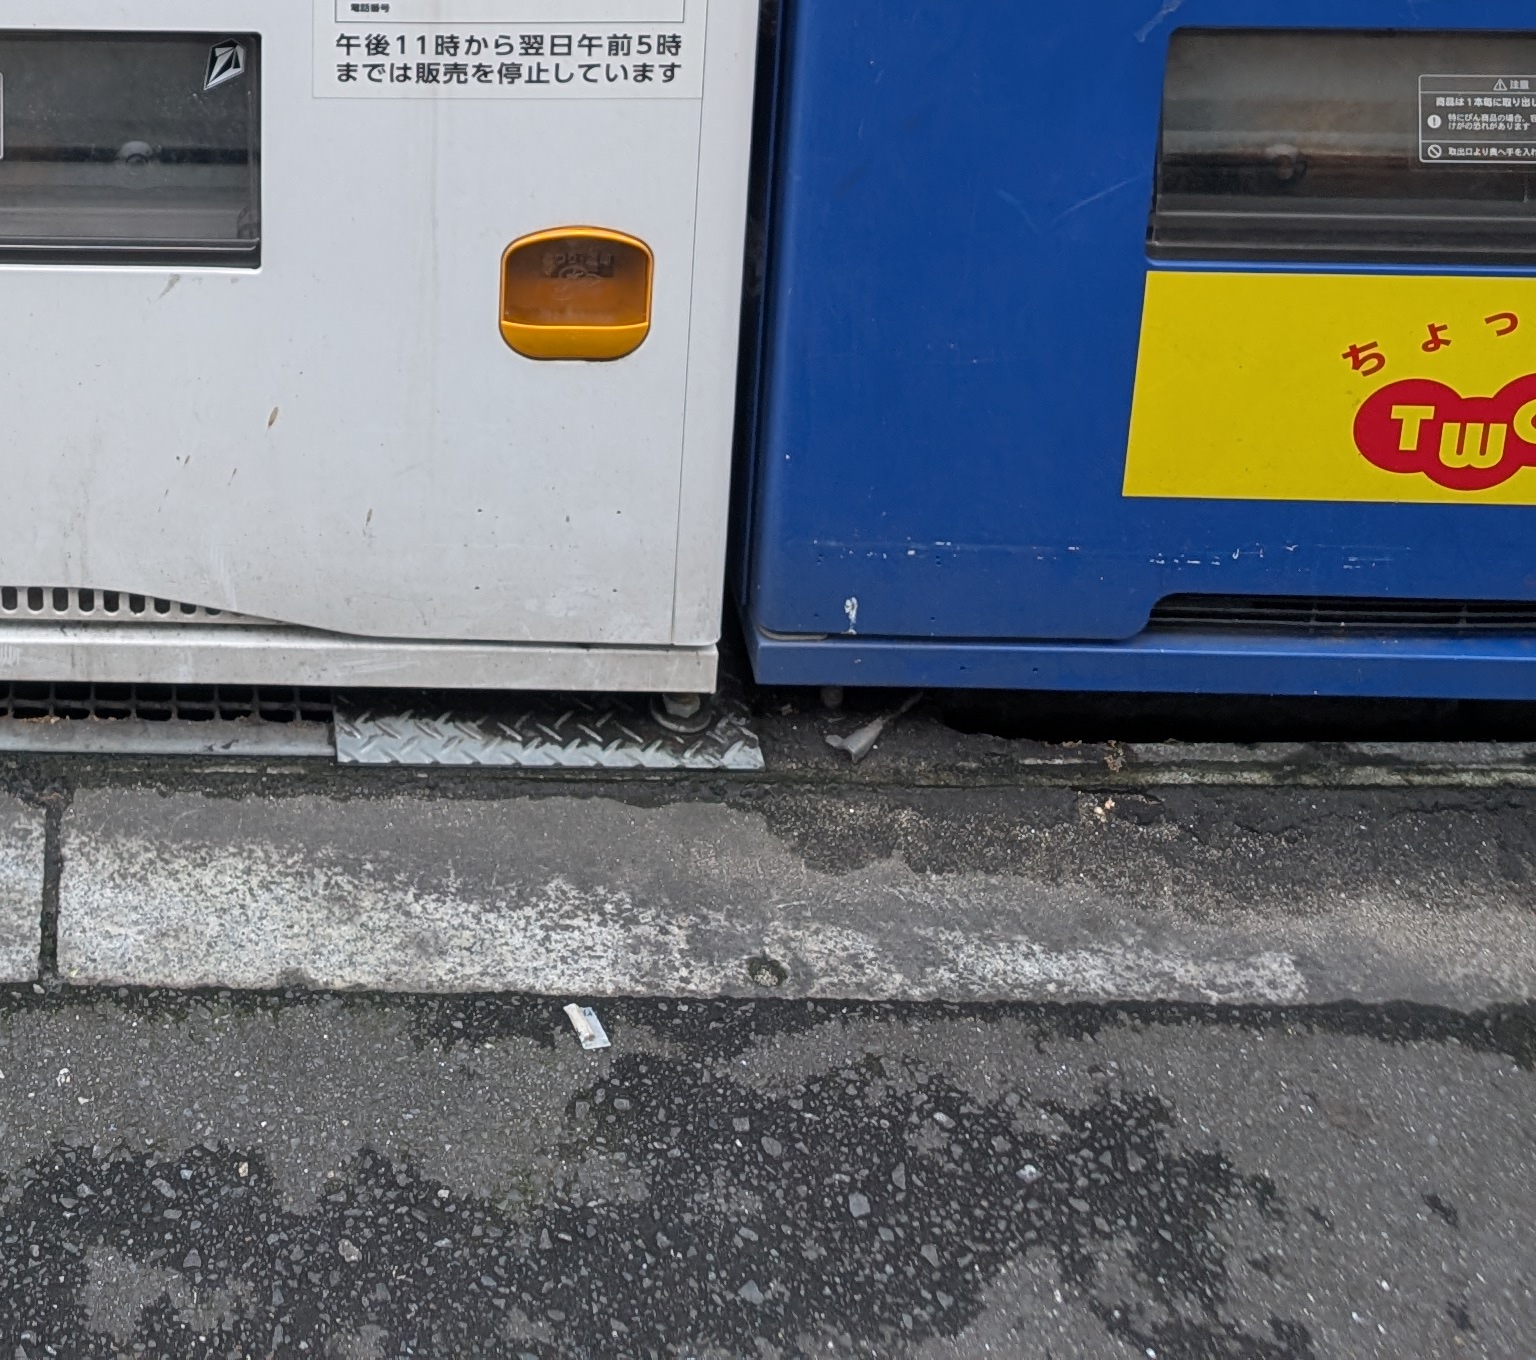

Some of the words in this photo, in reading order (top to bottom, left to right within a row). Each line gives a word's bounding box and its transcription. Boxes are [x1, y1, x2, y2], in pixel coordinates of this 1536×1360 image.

[335, 33, 683, 57] 午後11時から翌日午前5時
[336, 61, 683, 86] までは販売を停止しています
